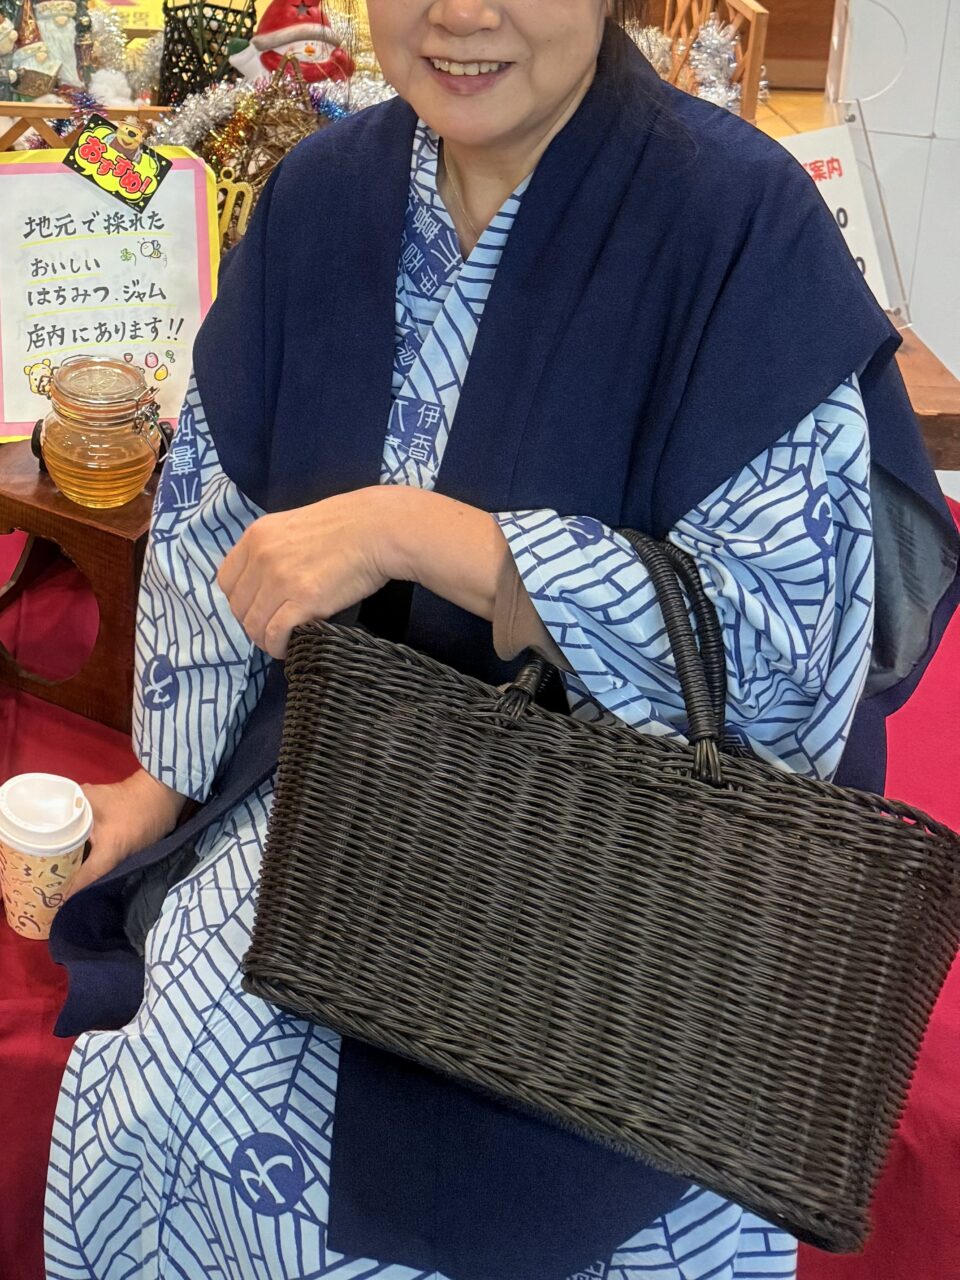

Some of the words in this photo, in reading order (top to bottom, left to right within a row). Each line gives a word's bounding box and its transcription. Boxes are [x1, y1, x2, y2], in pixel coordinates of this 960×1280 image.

[22, 210, 166, 240] 地元で採れた
[30, 256, 102, 278] おいしい
[25, 316, 186, 353] 店内にあります!!
